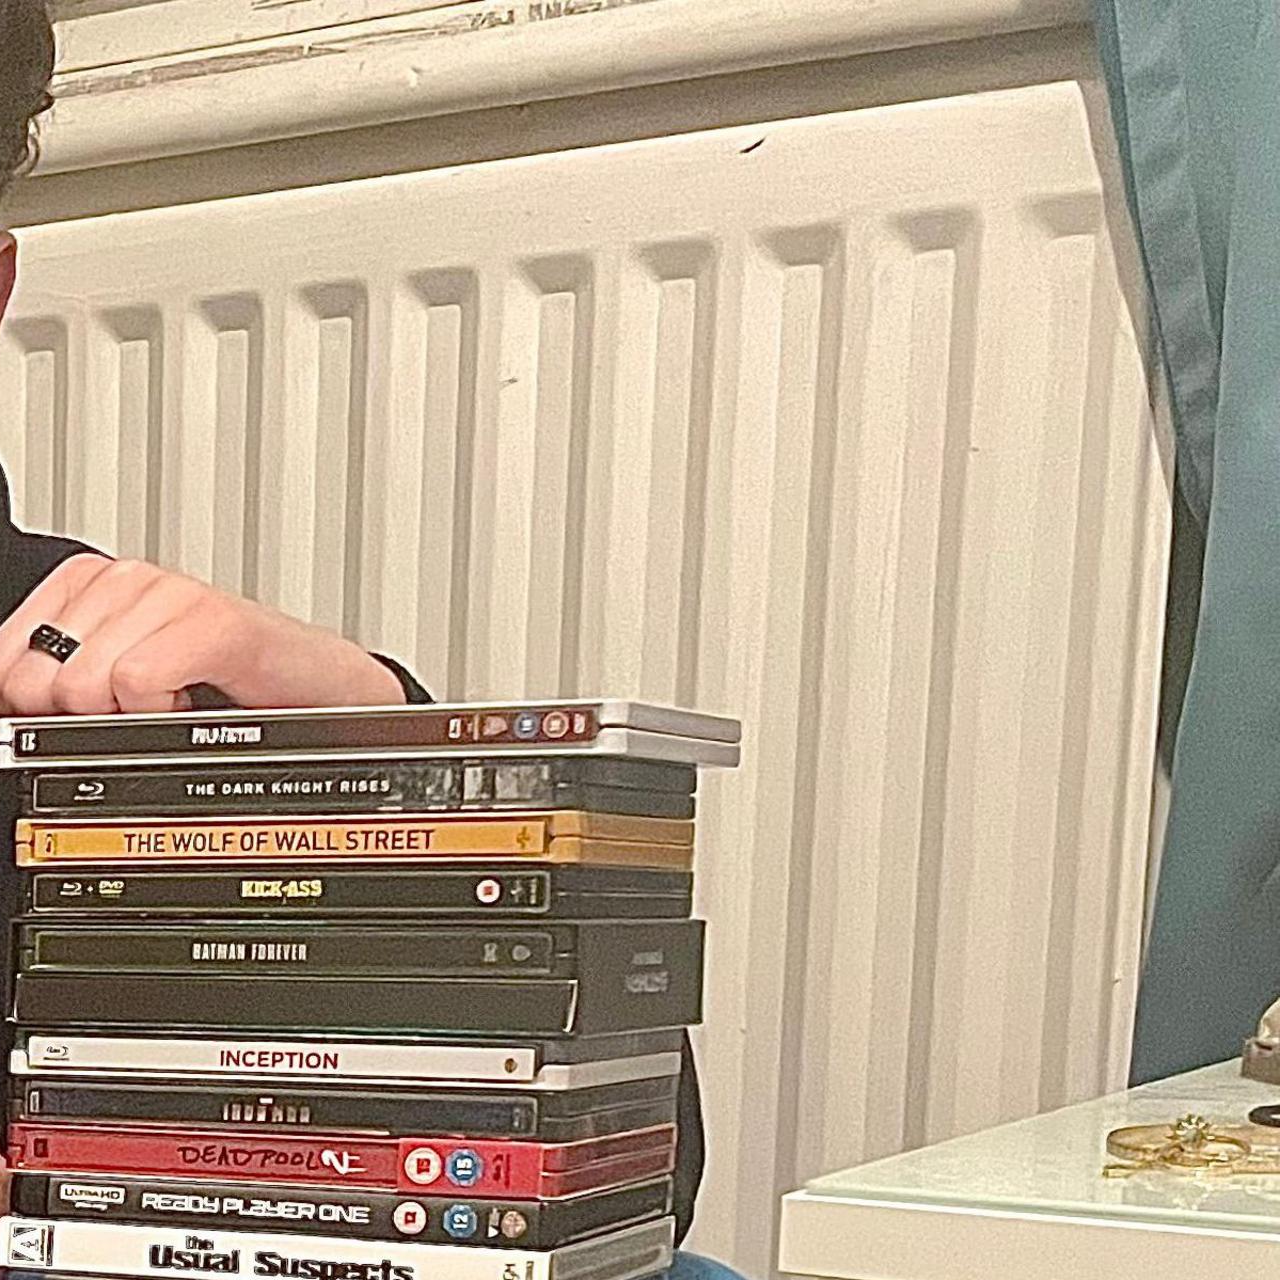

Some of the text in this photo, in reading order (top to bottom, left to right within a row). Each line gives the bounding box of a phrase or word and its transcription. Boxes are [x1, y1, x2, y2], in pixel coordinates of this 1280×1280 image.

[185, 780, 390, 796] THE DARK KNIGHT RISES
[124, 829, 436, 853] THE WOLF OF WALL STREET
[192, 943, 307, 961] BATMAN FOREVER
[219, 1050, 339, 1070] INCEPTION
[177, 1145, 319, 1172] DEADPOOL
[456, 1157, 473, 1176] 15
[101, 1189, 121, 1201] HD
[142, 1194, 370, 1223] READY PLAYER ONE
[453, 1213, 469, 1229] 12
[184, 1234, 215, 1251] the
[148, 1244, 240, 1274] Usual
